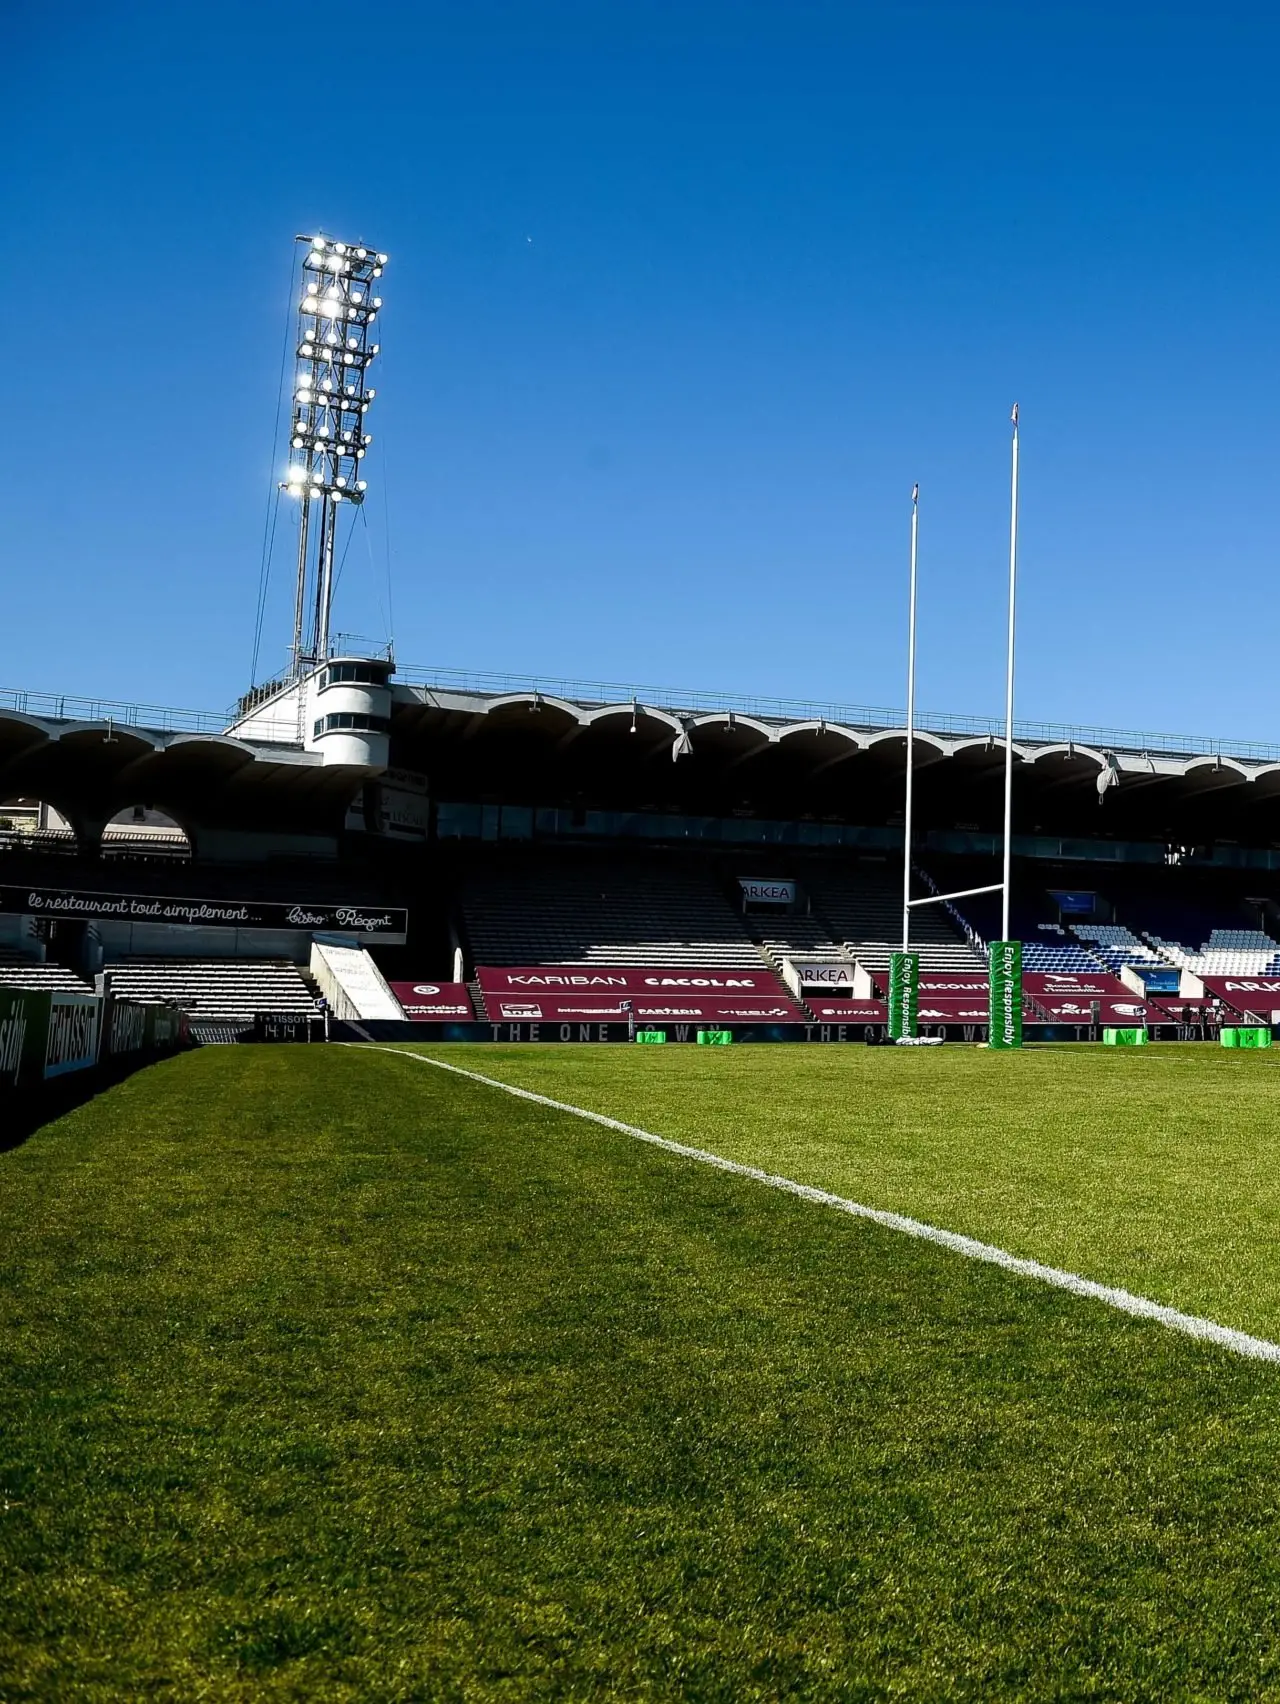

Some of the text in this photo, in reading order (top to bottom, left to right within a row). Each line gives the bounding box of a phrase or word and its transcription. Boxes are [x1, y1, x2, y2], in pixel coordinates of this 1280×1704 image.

[28, 892, 43, 908] le
[45, 896, 128, 913] restaurant
[130, 900, 162, 915] tout
[507, 976, 755, 987] KARIBAN CACOLAC
[902, 958, 912, 1037] Enjoy Responsibl
[1003, 947, 1014, 1045] Enjoy Responsibly
[271, 1014, 305, 1024] TISSOT
[491, 1024, 608, 1041] THE ONE
[804, 1025, 847, 1041] THE
